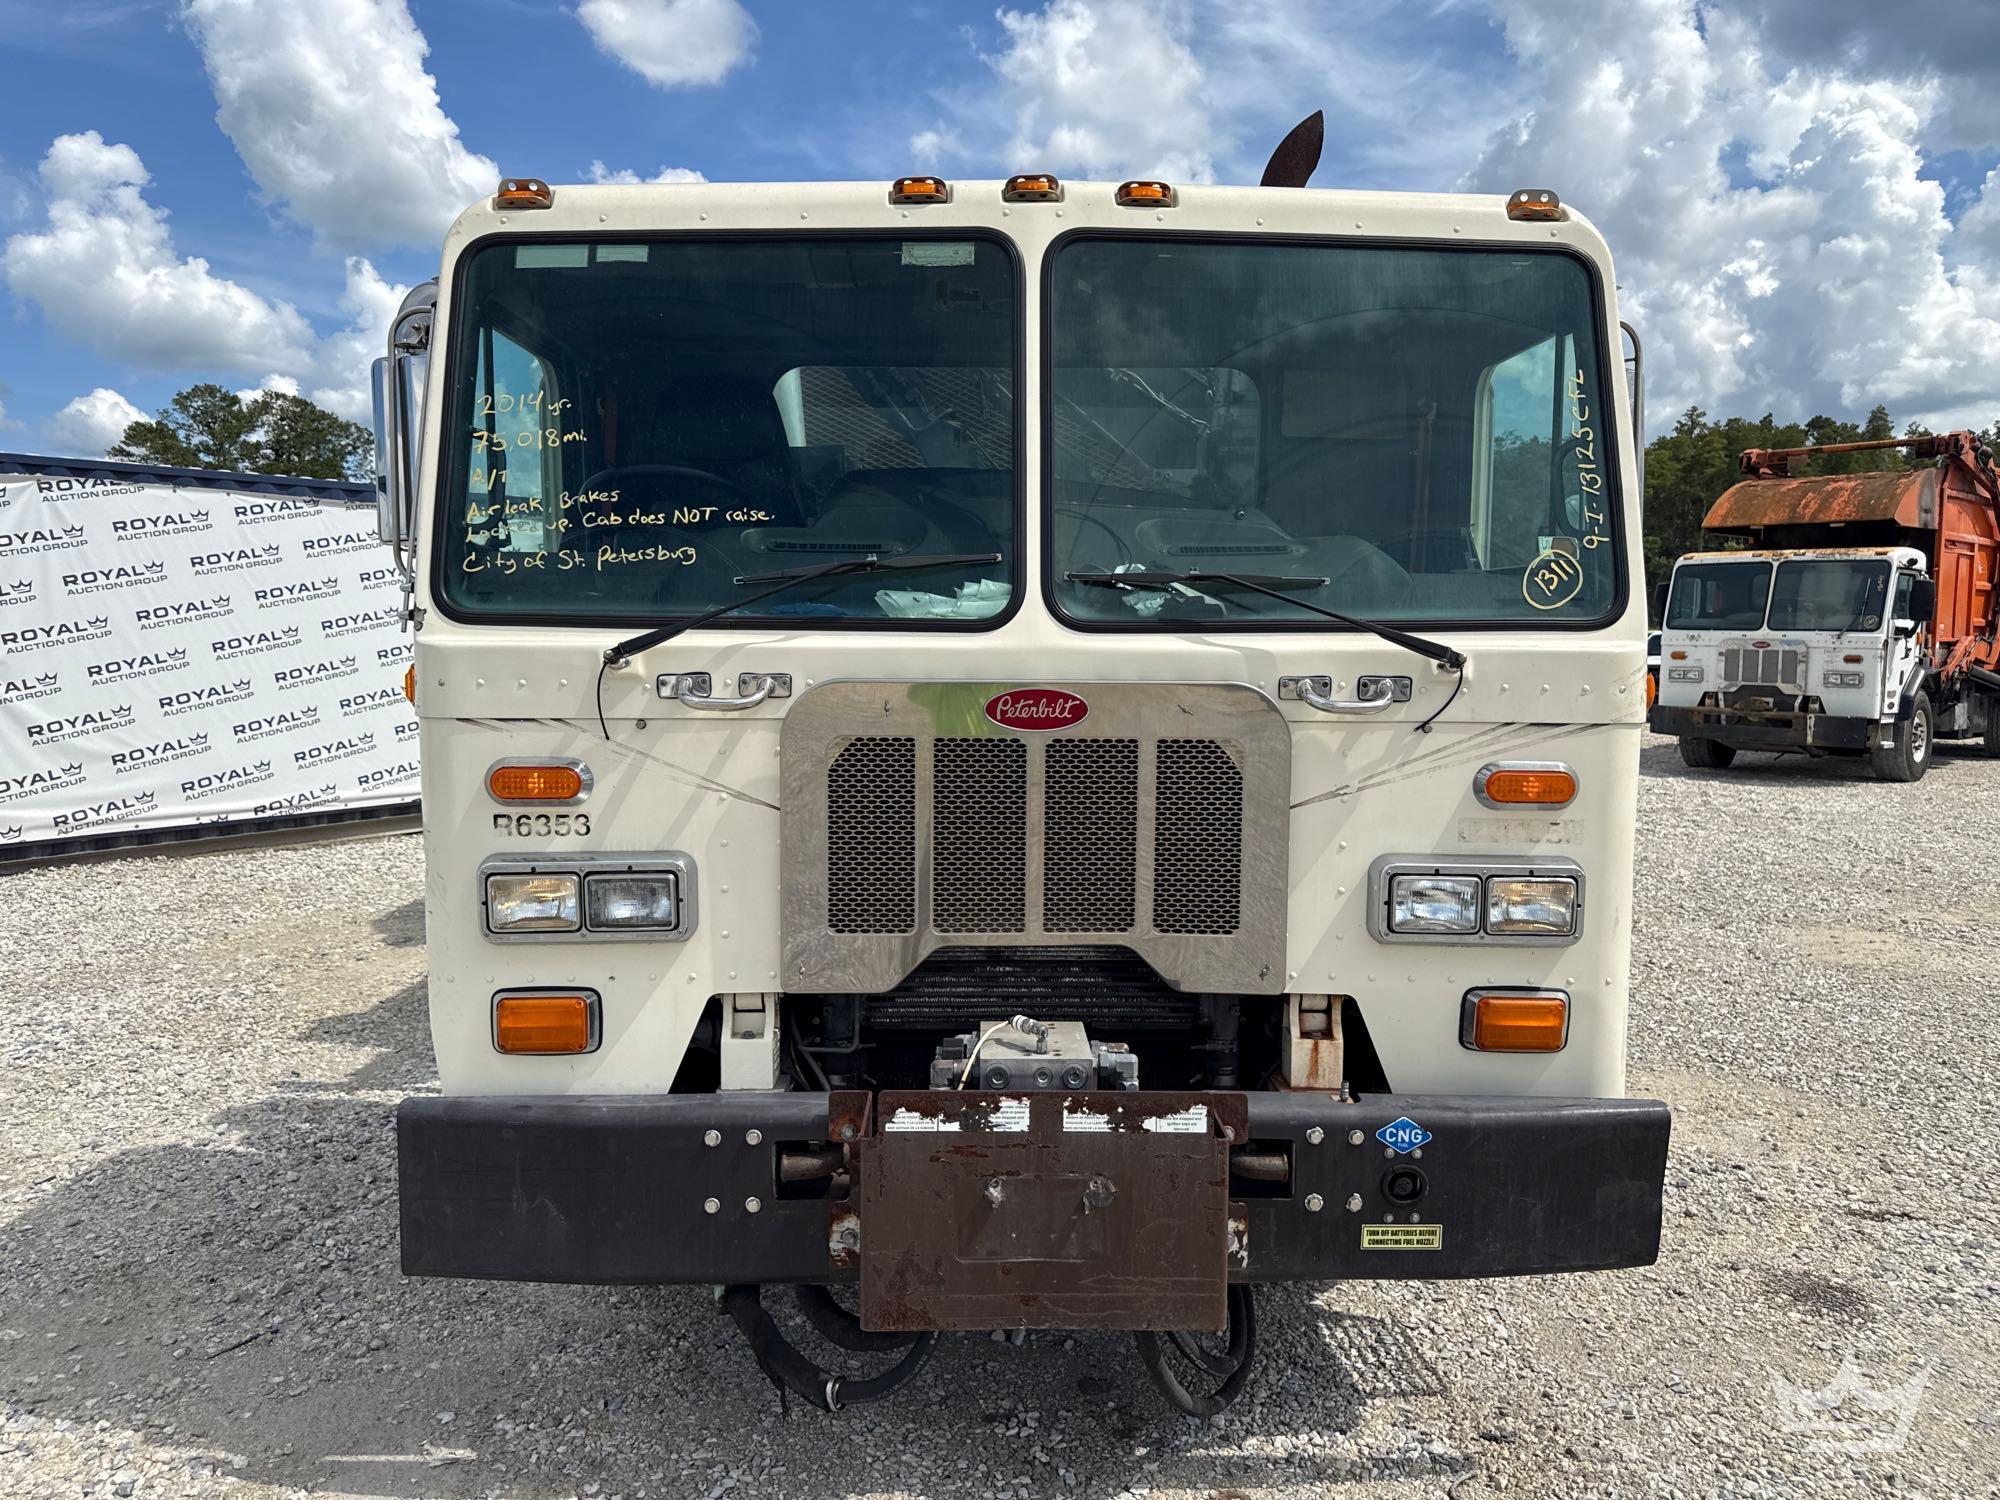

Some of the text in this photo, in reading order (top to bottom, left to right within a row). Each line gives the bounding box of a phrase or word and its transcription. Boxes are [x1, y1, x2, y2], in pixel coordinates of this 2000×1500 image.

[477, 391, 544, 416] 2014
[473, 429, 588, 454] 75,018 mi.
[471, 468, 511, 490] A/T
[42, 486, 144, 502] AUCTION GROUP
[234, 500, 304, 518] ROYAL
[238, 509, 322, 526] AUCTION GROUP
[466, 502, 500, 524] Air
[560, 490, 620, 510] Brakes
[112, 514, 191, 532] ROYAL
[546, 517, 573, 533] up.
[582, 512, 622, 528] Cab
[628, 509, 666, 526] does
[672, 507, 718, 524] NOT
[726, 510, 776, 522] raise.
[0, 529, 63, 547] OYAL
[117, 524, 213, 542] AUCTION GROUP
[302, 532, 367, 550] ROYAL
[0, 540, 88, 557] CTION GROUP
[190, 548, 262, 568] ROYAL
[306, 547, 350, 559] AUCTION
[463, 545, 697, 574] City of St. Petersburg
[62, 566, 144, 586] ROYAL
[194, 557, 283, 576] AUCTION GROUP
[360, 568, 397, 582] ROY
[67, 574, 168, 596] AUCTION GROUP
[255, 581, 322, 600] ROYAL
[0, 595, 37, 606] ROUP
[258, 589, 341, 610] AUCTION GROUP
[136, 600, 213, 622] ROYAL
[140, 608, 234, 630] AUCTION GROUP
[321, 611, 384, 631] ROYAL
[1, 621, 88, 645] ROYAL
[6, 630, 112, 654] AUCTION GROUP
[212, 631, 282, 653] ROYAL
[324, 626, 368, 639] AUCTION
[216, 639, 302, 661] AUCTION GROUP
[377, 644, 414, 660] ROY
[87, 653, 168, 678] ROYAL
[274, 661, 340, 684] ROYAL
[380, 656, 414, 668] AUCTIO
[92, 661, 190, 686] AUCTION GROUP
[278, 668, 359, 691] AUCTION GROUP
[16, 686, 62, 702] GROUP
[159, 684, 234, 708] ROYAL
[163, 692, 254, 717] AUCTION GROUP
[340, 688, 402, 710] ROYAL
[342, 697, 406, 717] AUCTION GRO
[996, 696, 1080, 720] Peterbilt
[27, 711, 112, 738] ROYAL
[32, 718, 136, 746] AUCTION GROUP
[232, 712, 301, 736] ROYAL
[236, 718, 321, 744] AUCTION GROUP
[111, 738, 190, 765] ROYAL
[116, 745, 212, 775] AUCTION GROUP
[294, 738, 359, 762] ROYAL
[297, 744, 377, 770] AUCTION GROUP
[0, 770, 62, 794] OYAL
[181, 766, 254, 793] ROYAL
[358, 762, 418, 786] ROYAL
[362, 776, 402, 792] AUCTION
[0, 776, 86, 803] CTION GROUP
[185, 772, 274, 801] AUCTION GROUP
[53, 798, 135, 827] ROYAL
[254, 790, 321, 816] ROYAL
[304, 796, 341, 810] GROUP
[57, 804, 158, 836] AUCTION GROUP
[492, 814, 591, 837] R6353
[1386, 1128, 1423, 1143] CNG
